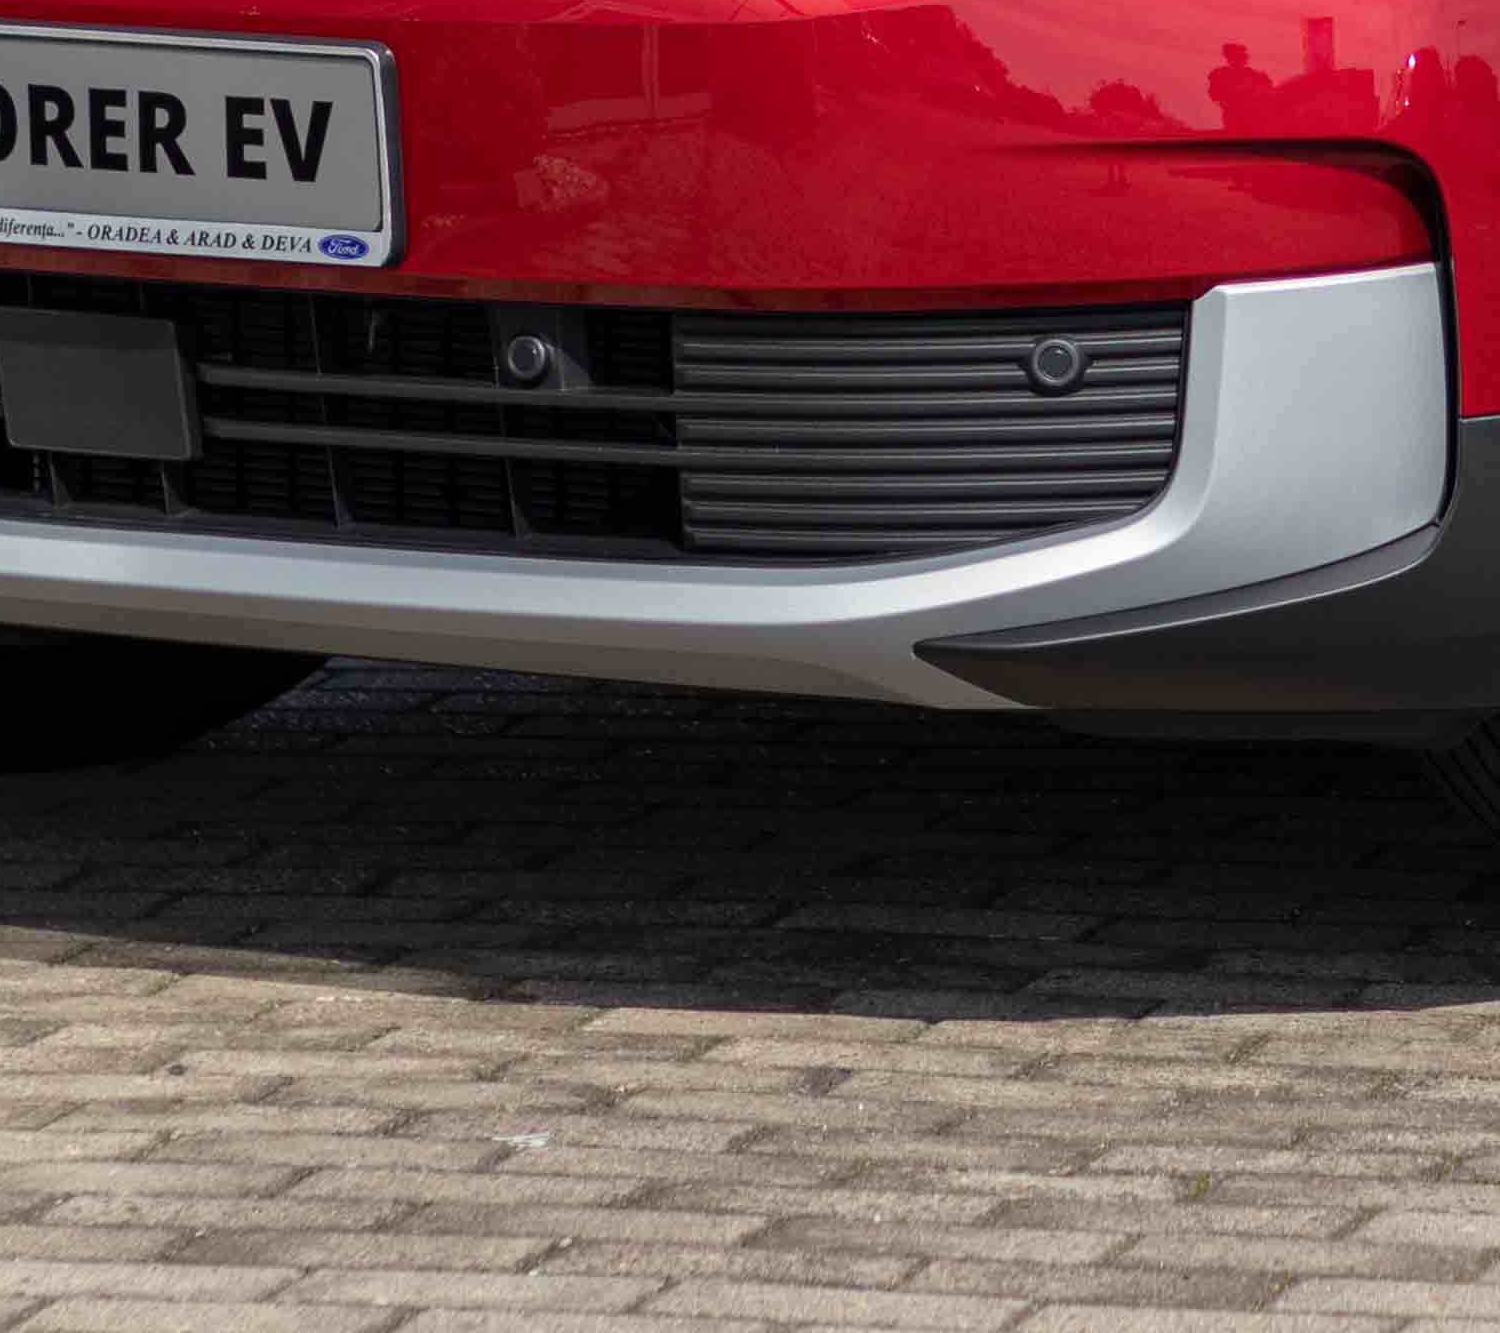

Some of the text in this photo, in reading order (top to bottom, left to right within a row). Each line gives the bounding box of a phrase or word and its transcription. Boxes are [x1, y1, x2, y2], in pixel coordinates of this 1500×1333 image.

[224, 95, 334, 183] EV
[87, 223, 161, 245] ORADEA
[165, 228, 180, 245] &
[183, 229, 238, 249] ARAD
[242, 232, 256, 249] &
[260, 233, 312, 253] DEVA
